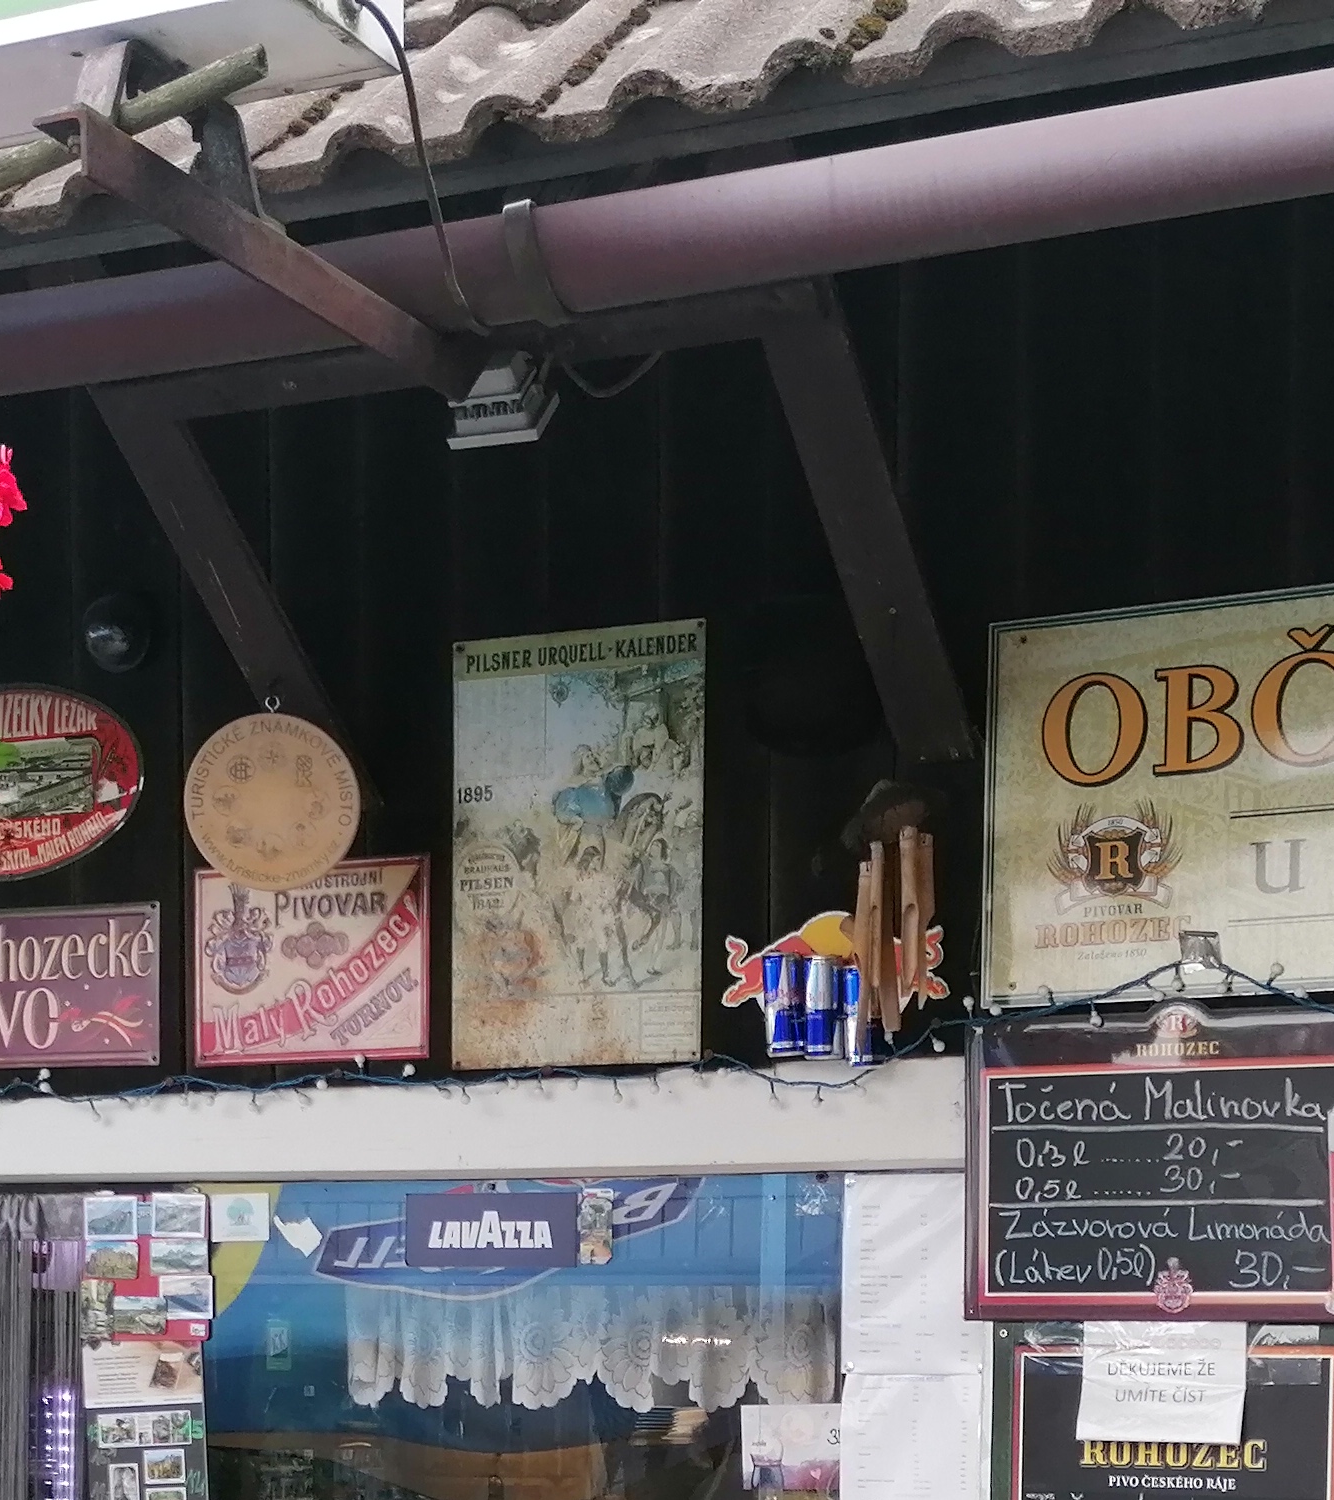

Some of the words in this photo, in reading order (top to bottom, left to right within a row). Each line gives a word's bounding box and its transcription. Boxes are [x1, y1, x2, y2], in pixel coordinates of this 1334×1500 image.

[466, 650, 532, 674] PILSNER
[191, 723, 245, 821] TURISTICKÉ
[250, 719, 340, 768] ZNÁMKOVÉ
[337, 768, 353, 827] MÍSTO
[457, 785, 493, 804] 1895
[1250, 840, 1308, 896] U
[460, 876, 513, 892] PILSEN
[274, 891, 387, 928] PIVOVAR
[1083, 903, 1143, 917] PIVOVAR
[998, 1081, 1131, 1123] Točená
[1144, 1076, 1326, 1121] Malinovka
[428, 1209, 553, 1249] LAVAZZA
[999, 1208, 1177, 1241] Zázvorová
[1188, 1206, 1332, 1244] Limonáda
[1108, 1362, 1195, 1377] DĚKUJEME
[1198, 1361, 1216, 1376] ŽE
[1116, 1387, 1166, 1403] UMÍTE
[1173, 1385, 1206, 1402] ČÍST
[1108, 1476, 1139, 1488] PIVO
[1141, 1474, 1203, 1490] ČESKÉHO
[1207, 1475, 1237, 1492] RÁJE
